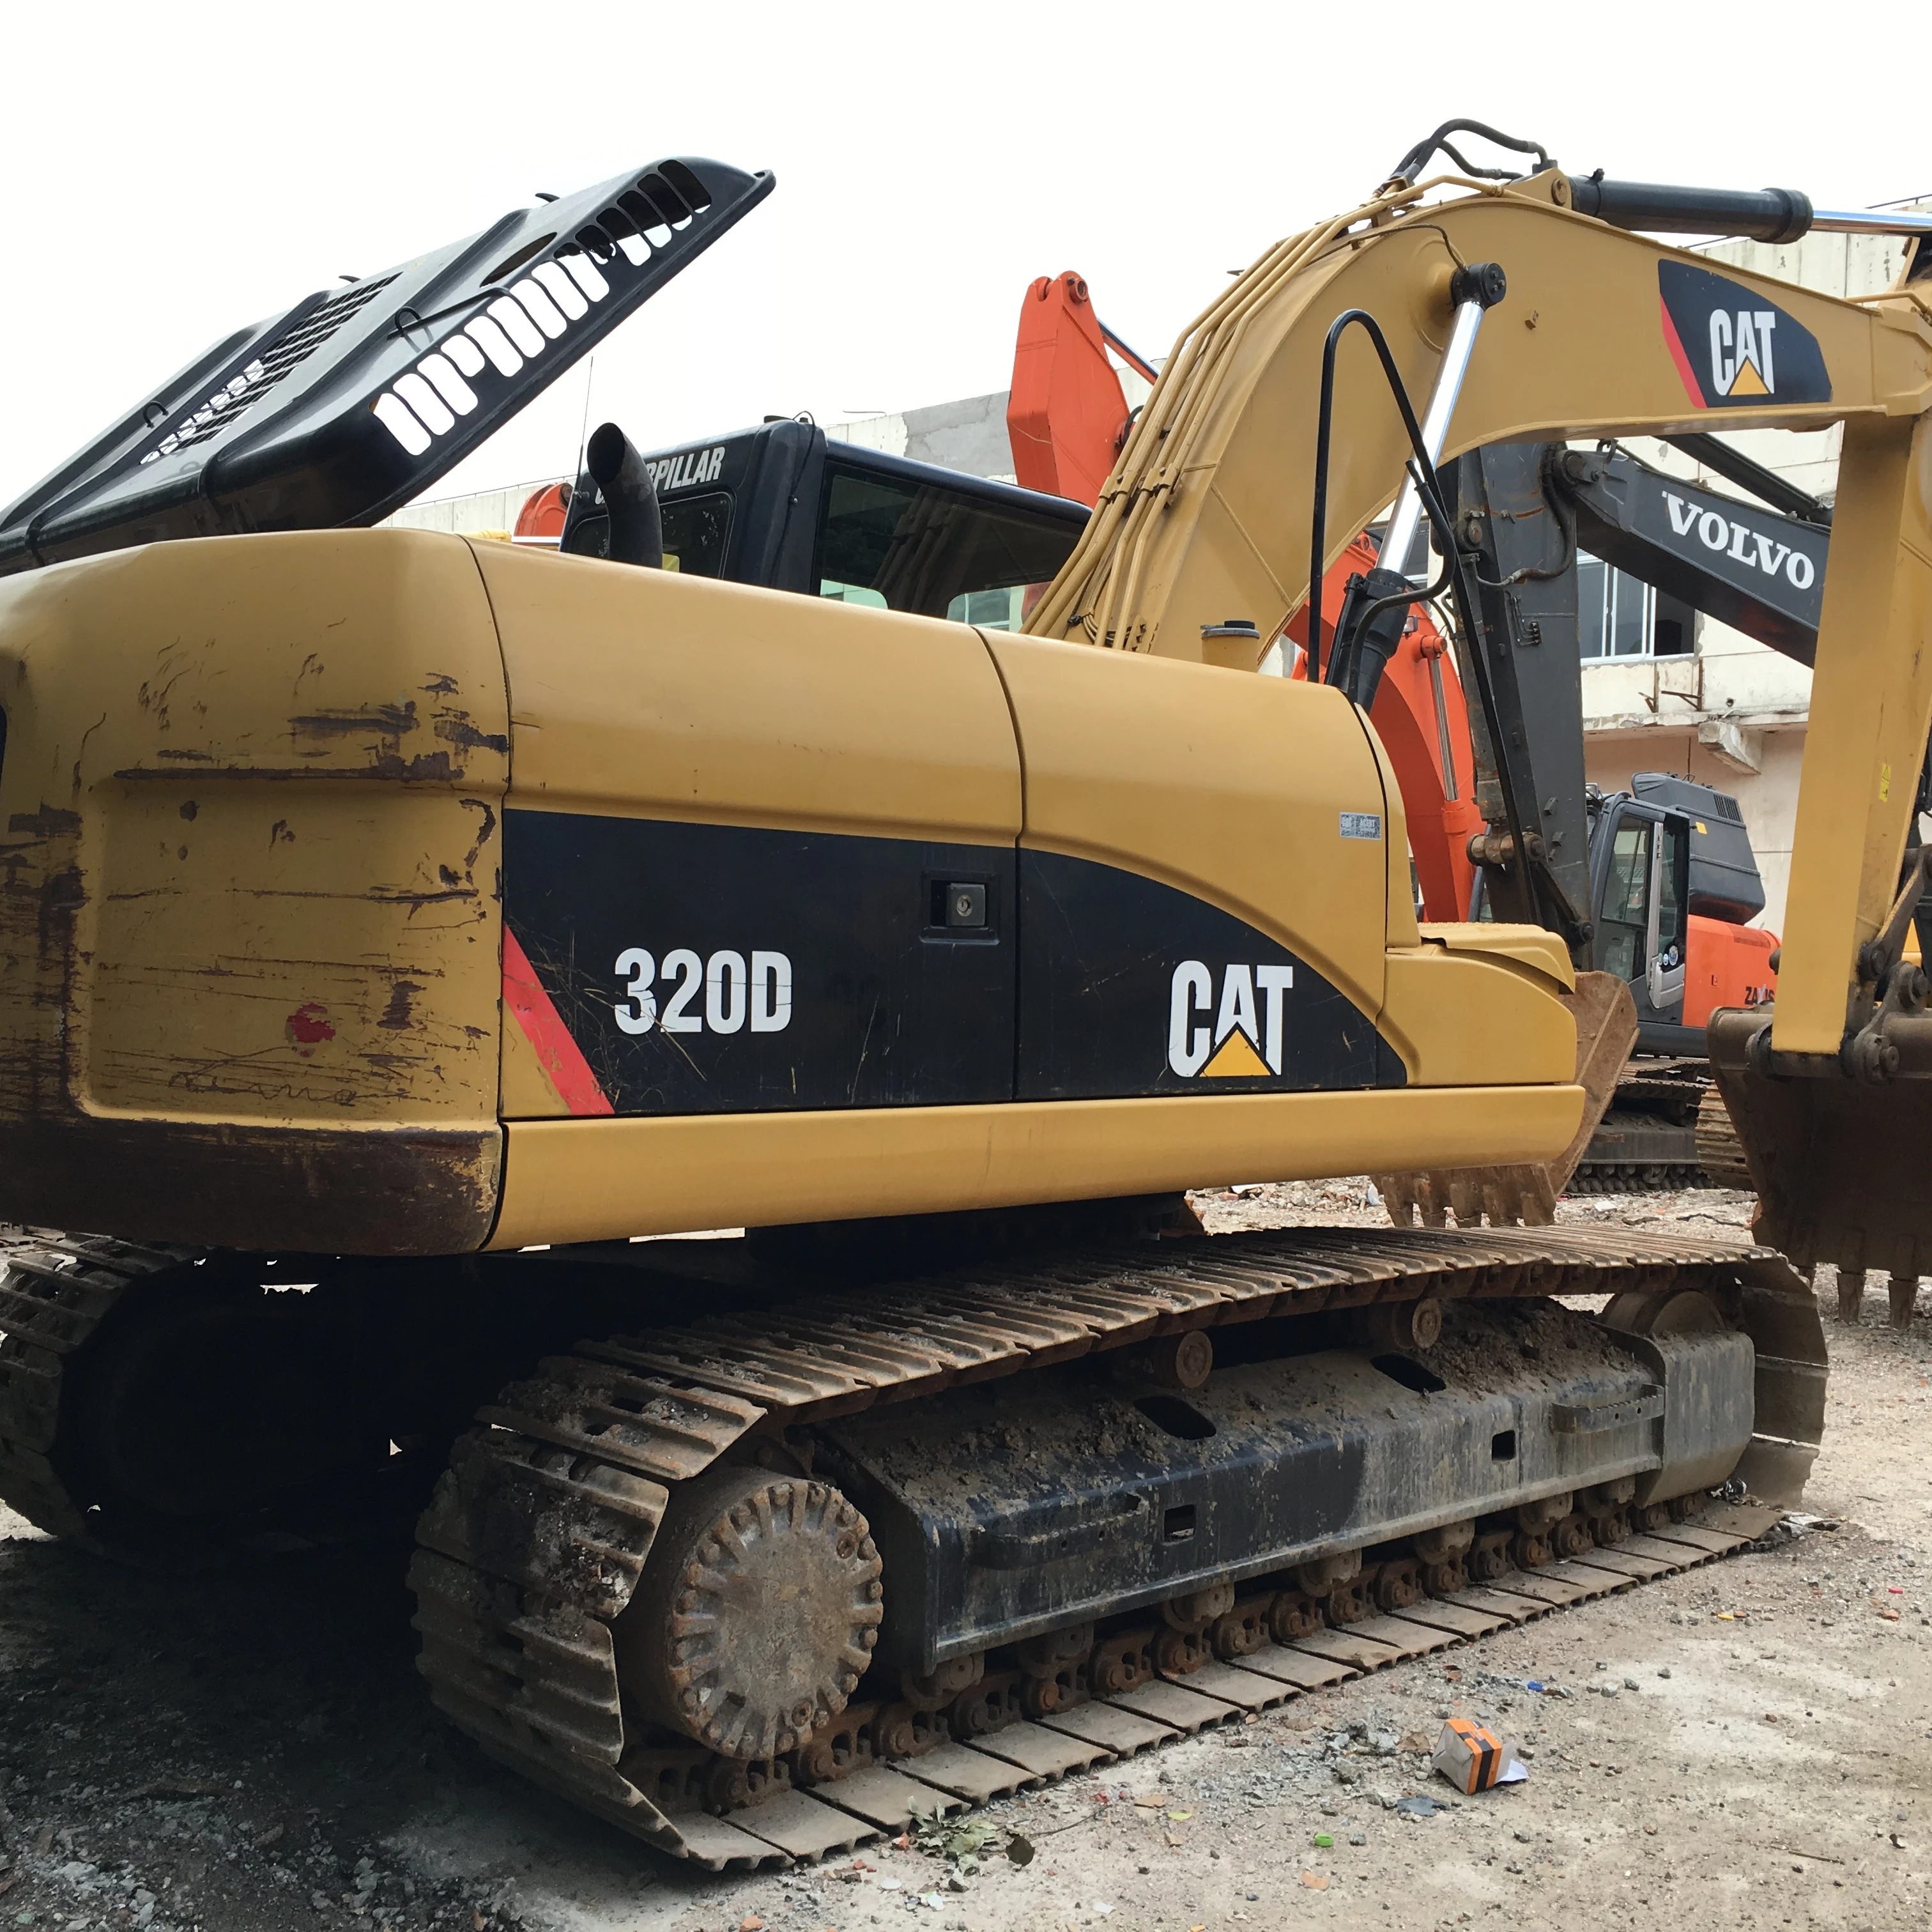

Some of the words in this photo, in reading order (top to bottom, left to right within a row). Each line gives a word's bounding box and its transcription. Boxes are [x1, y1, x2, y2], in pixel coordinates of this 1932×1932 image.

[1710, 309, 1775, 396] CAT
[1662, 491, 1815, 590] VOLVO
[614, 947, 792, 1034] 320D
[1168, 960, 1293, 1078] CAT
